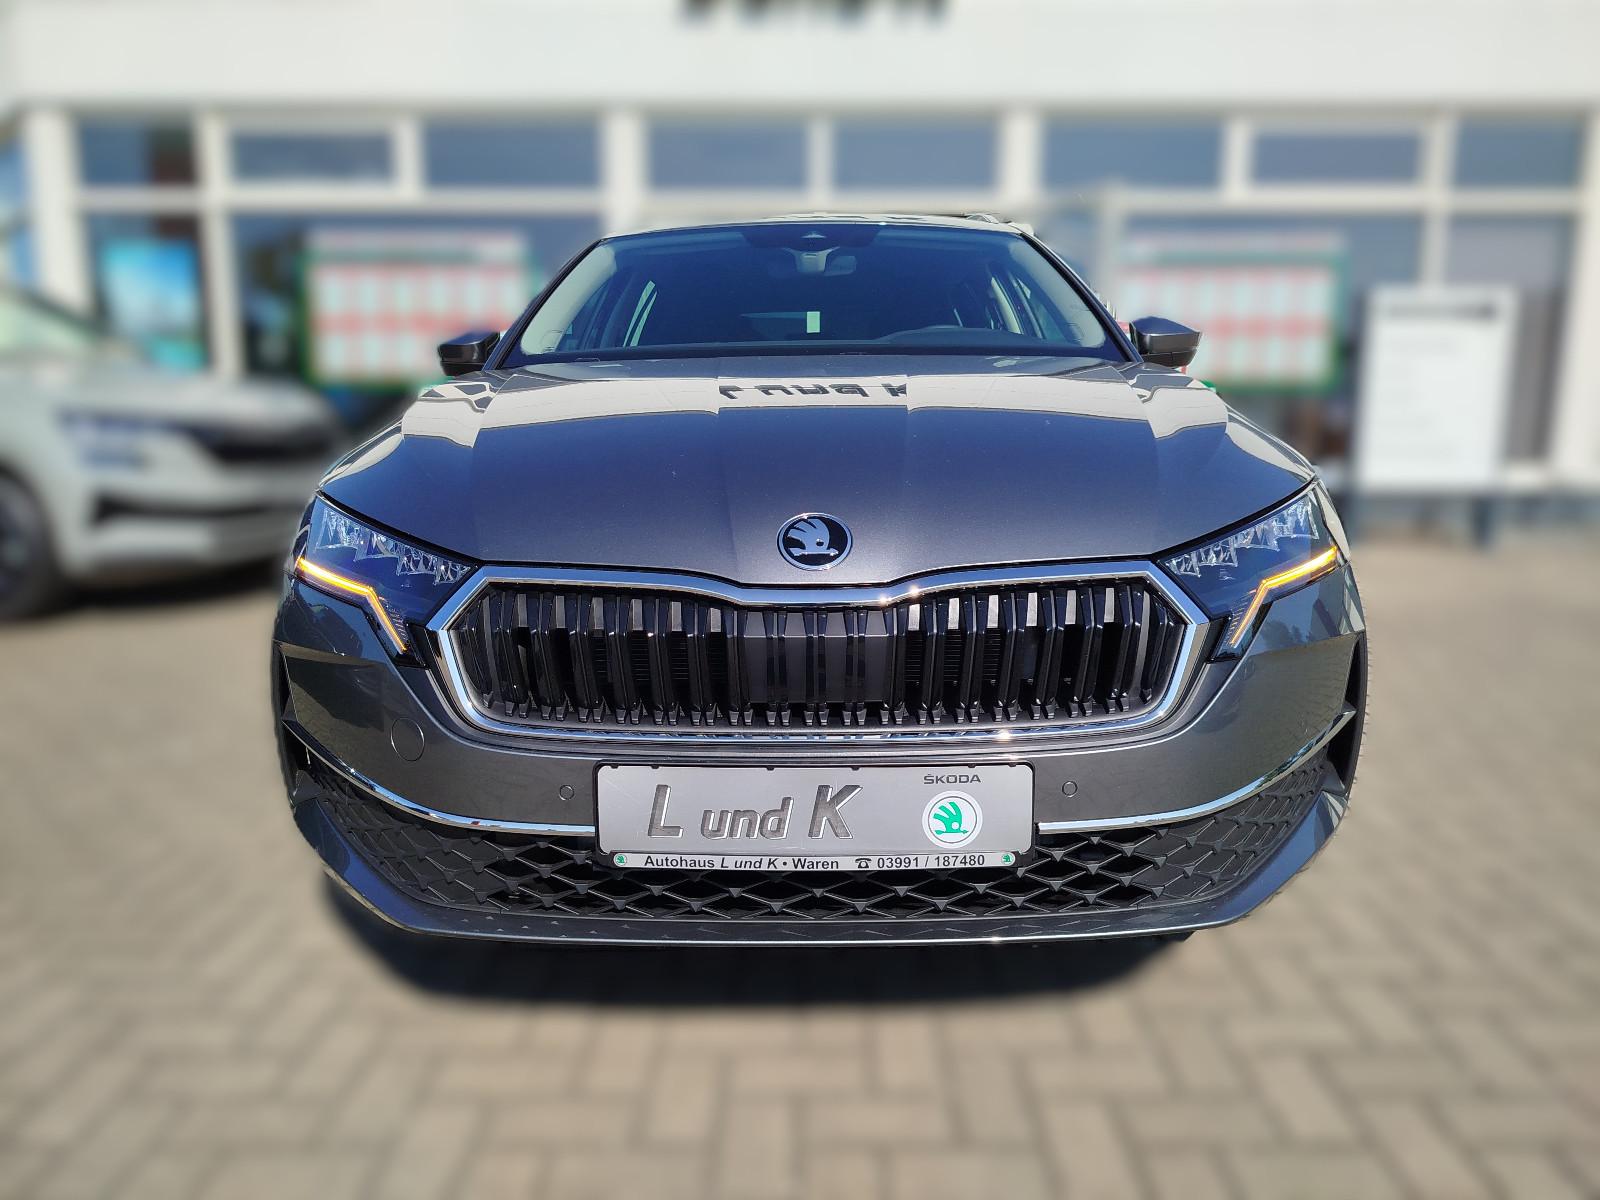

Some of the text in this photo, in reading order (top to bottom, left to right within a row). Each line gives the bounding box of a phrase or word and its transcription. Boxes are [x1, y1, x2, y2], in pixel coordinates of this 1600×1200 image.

[923, 773, 981, 785] ŠKODA
[647, 784, 863, 840] L und K
[644, 855, 715, 868] Autohaus
[720, 856, 729, 868] L
[734, 857, 763, 869] und
[767, 858, 780, 869] K
[792, 857, 839, 869] Waren
[877, 856, 919, 869] 03991
[935, 854, 985, 867] 187480
